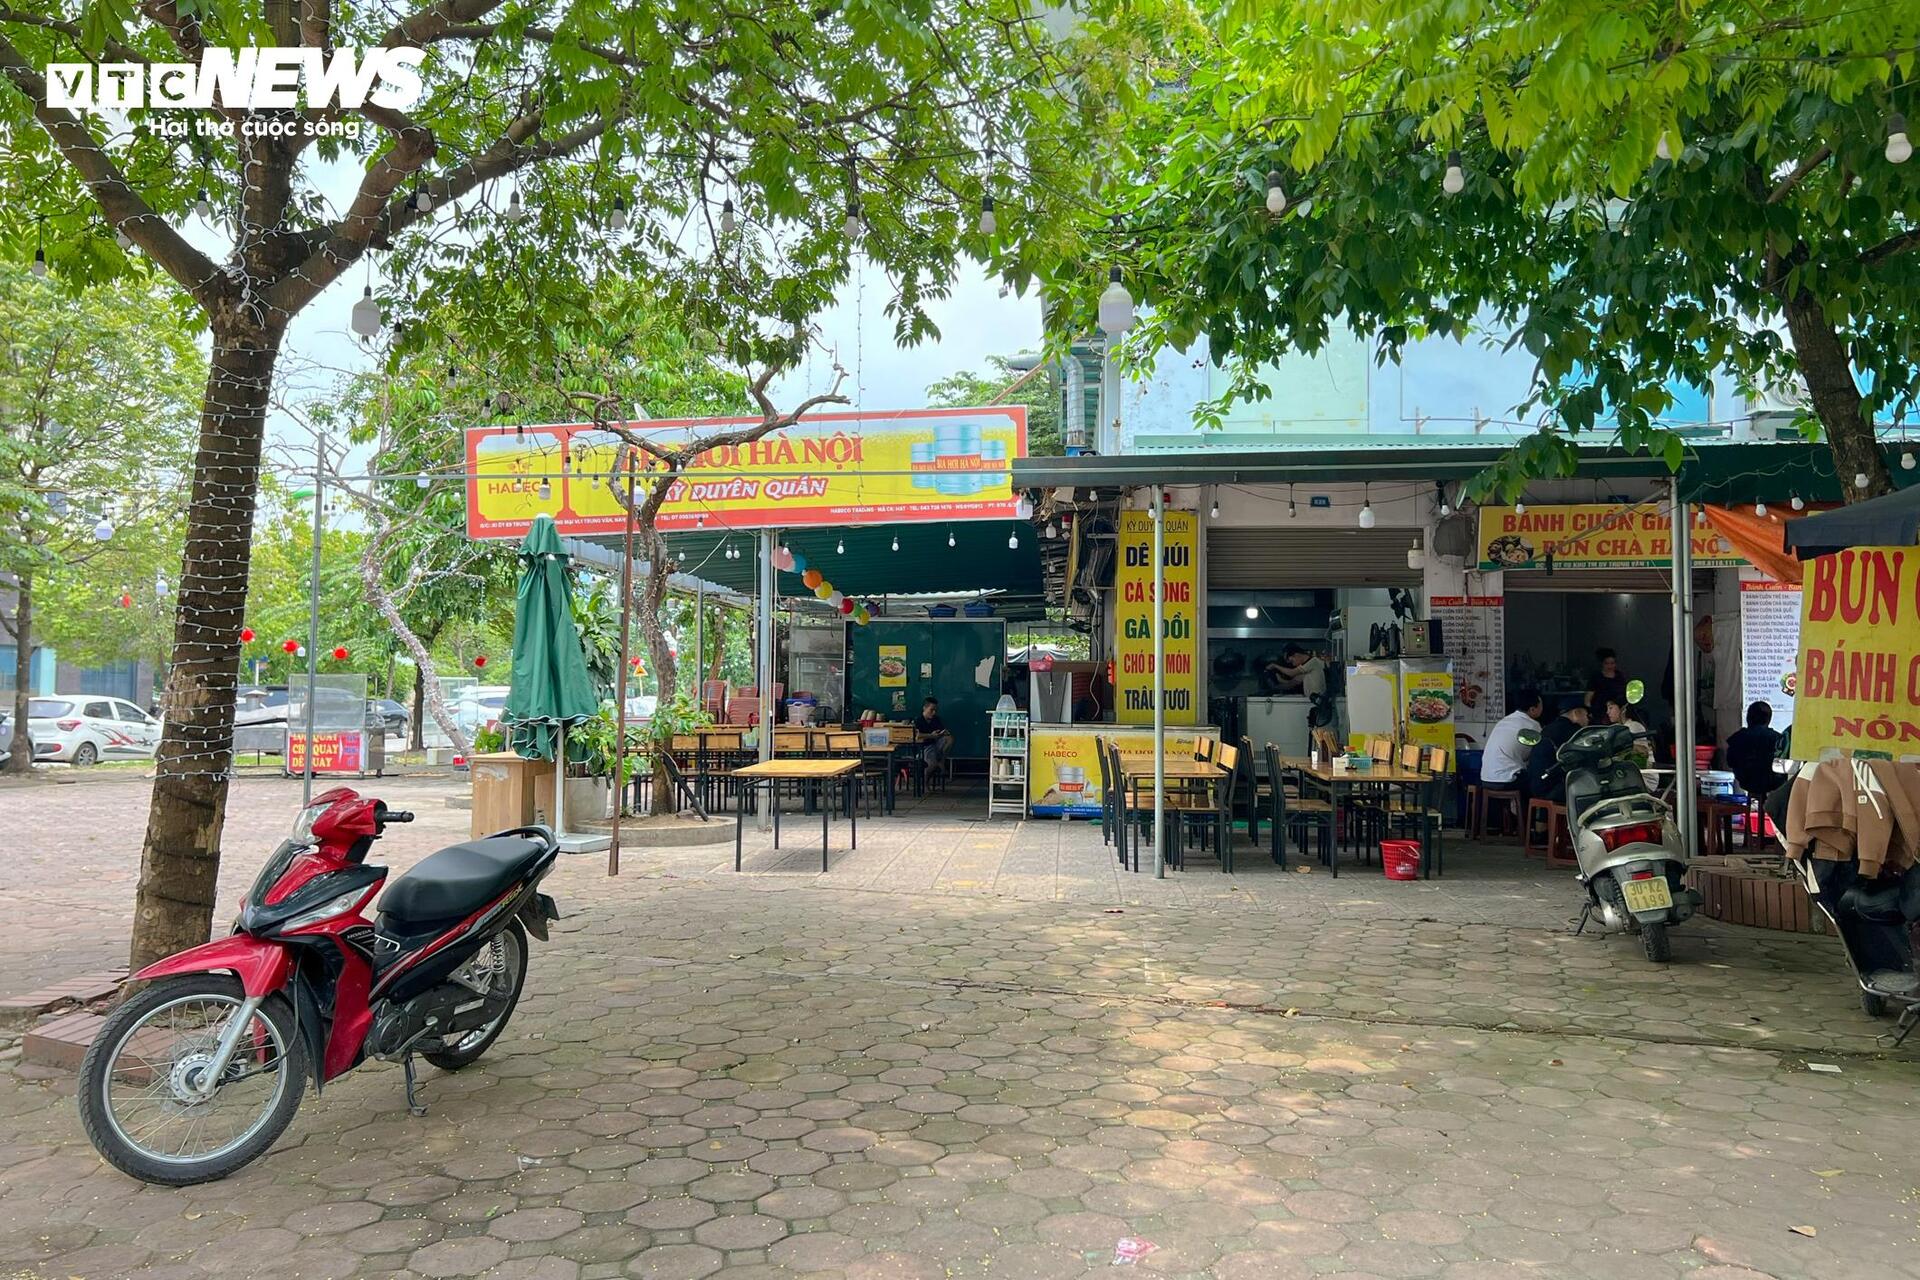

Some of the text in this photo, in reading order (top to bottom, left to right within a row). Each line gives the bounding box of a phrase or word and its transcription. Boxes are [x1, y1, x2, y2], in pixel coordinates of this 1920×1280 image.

[754, 432, 798, 465] HÀ
[802, 431, 864, 470] NỘI
[691, 478, 757, 500] DUYÊN
[765, 474, 826, 498] QUÁN
[1165, 519, 1189, 533] QUÁN
[1503, 510, 1564, 532] BÁNH
[1572, 506, 1634, 532] CUỐN
[1126, 542, 1149, 567] DÊ
[1124, 577, 1145, 603] CÁ
[1124, 613, 1151, 639] GÀ
[1124, 649, 1145, 674] CHÓ
[1166, 649, 1190, 674] MÓN
[1803, 639, 1898, 704] BÁNH
[292, 743, 306, 754] CH
[313, 743, 339, 756] QUAY
[313, 757, 332, 767] UAY
[1044, 750, 1077, 758] HABECO
